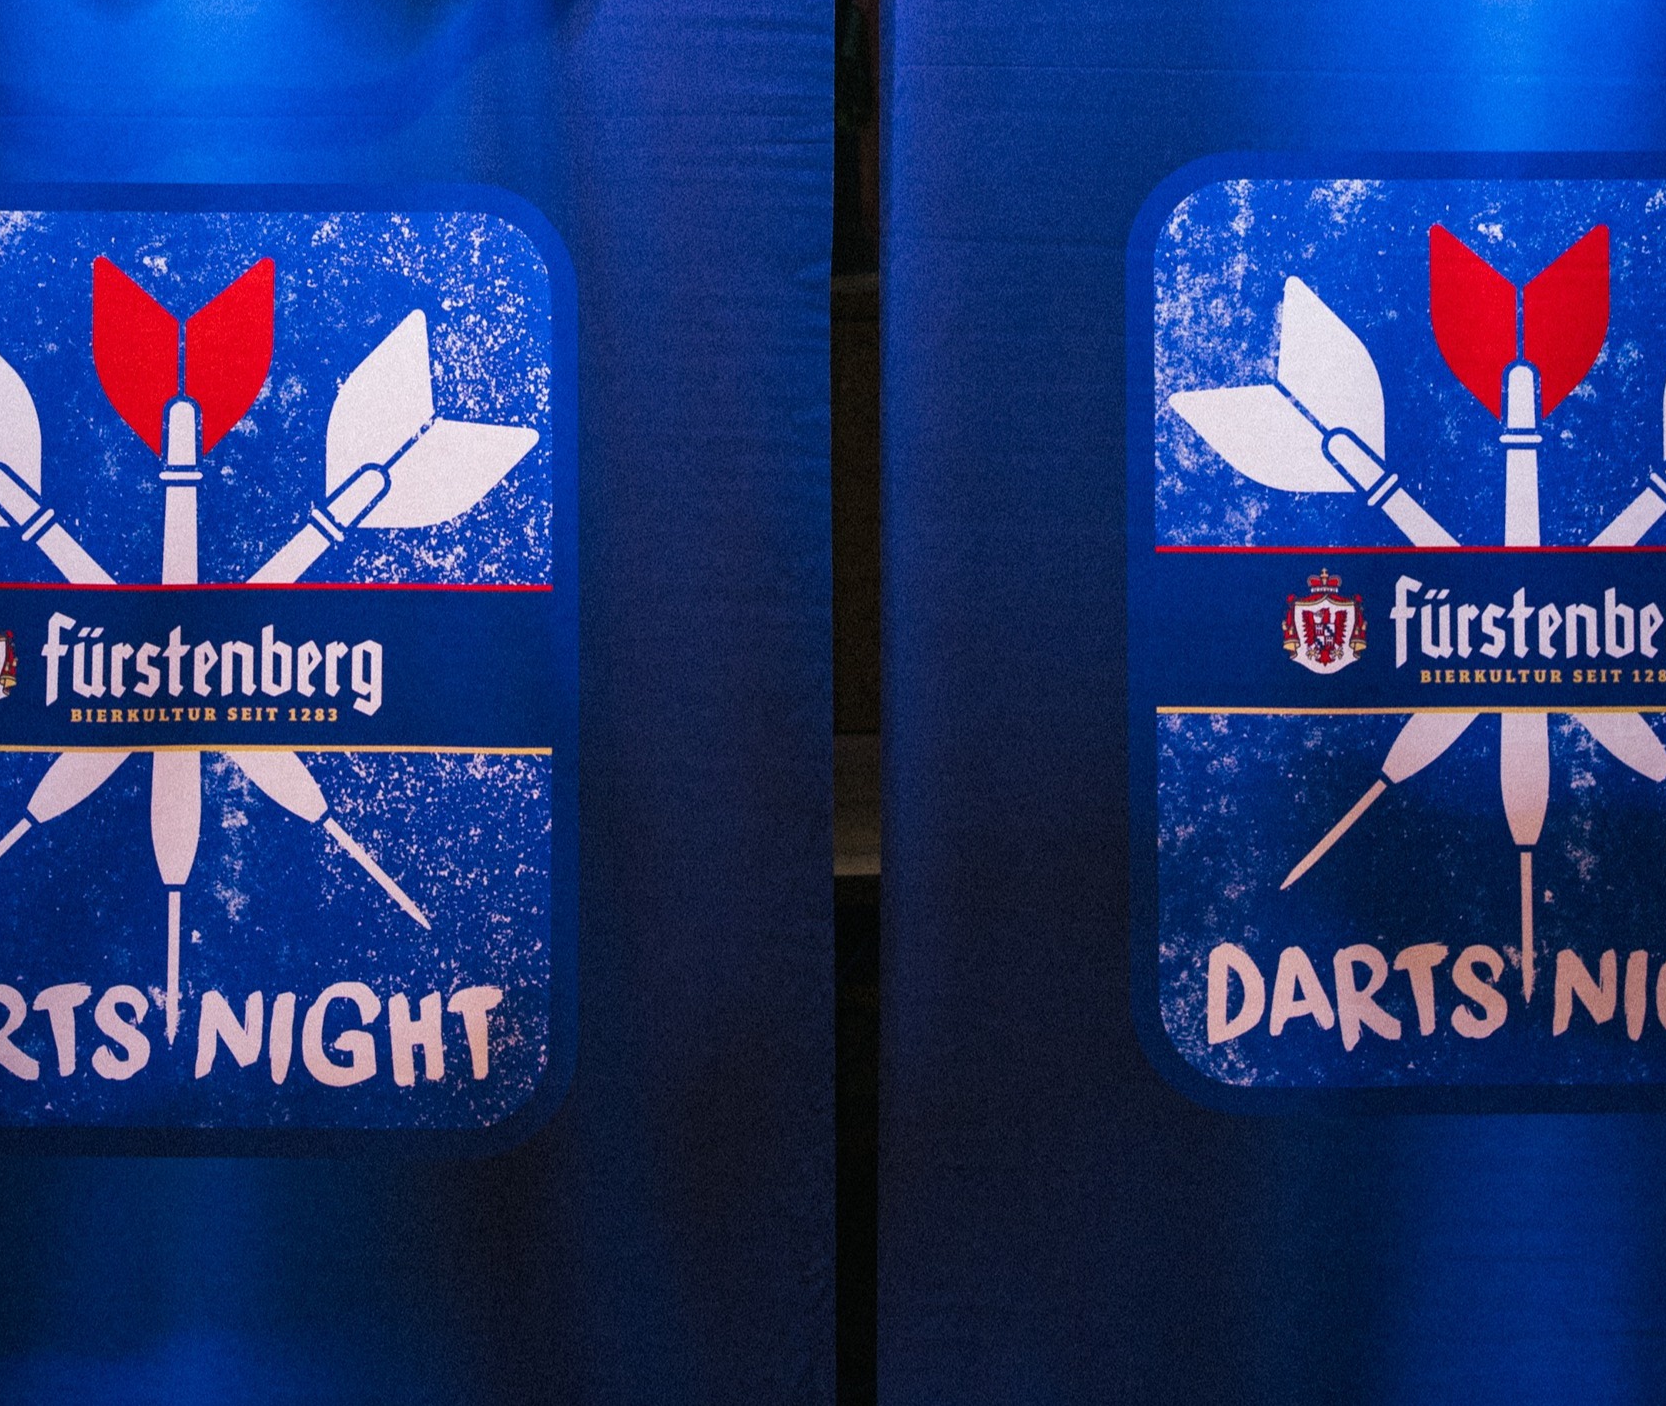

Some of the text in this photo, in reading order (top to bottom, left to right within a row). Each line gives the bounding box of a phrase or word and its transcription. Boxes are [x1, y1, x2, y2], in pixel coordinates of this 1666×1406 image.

[41, 611, 383, 717] fürstenberg
[70, 707, 339, 723] BIERKULTUR SEIT 1283
[1419, 669, 1563, 684] BIERKULTUR
[1572, 668, 1623, 684] SEIT
[194, 981, 505, 1087] NIGHT
[1207, 941, 1509, 1052] DARTS
